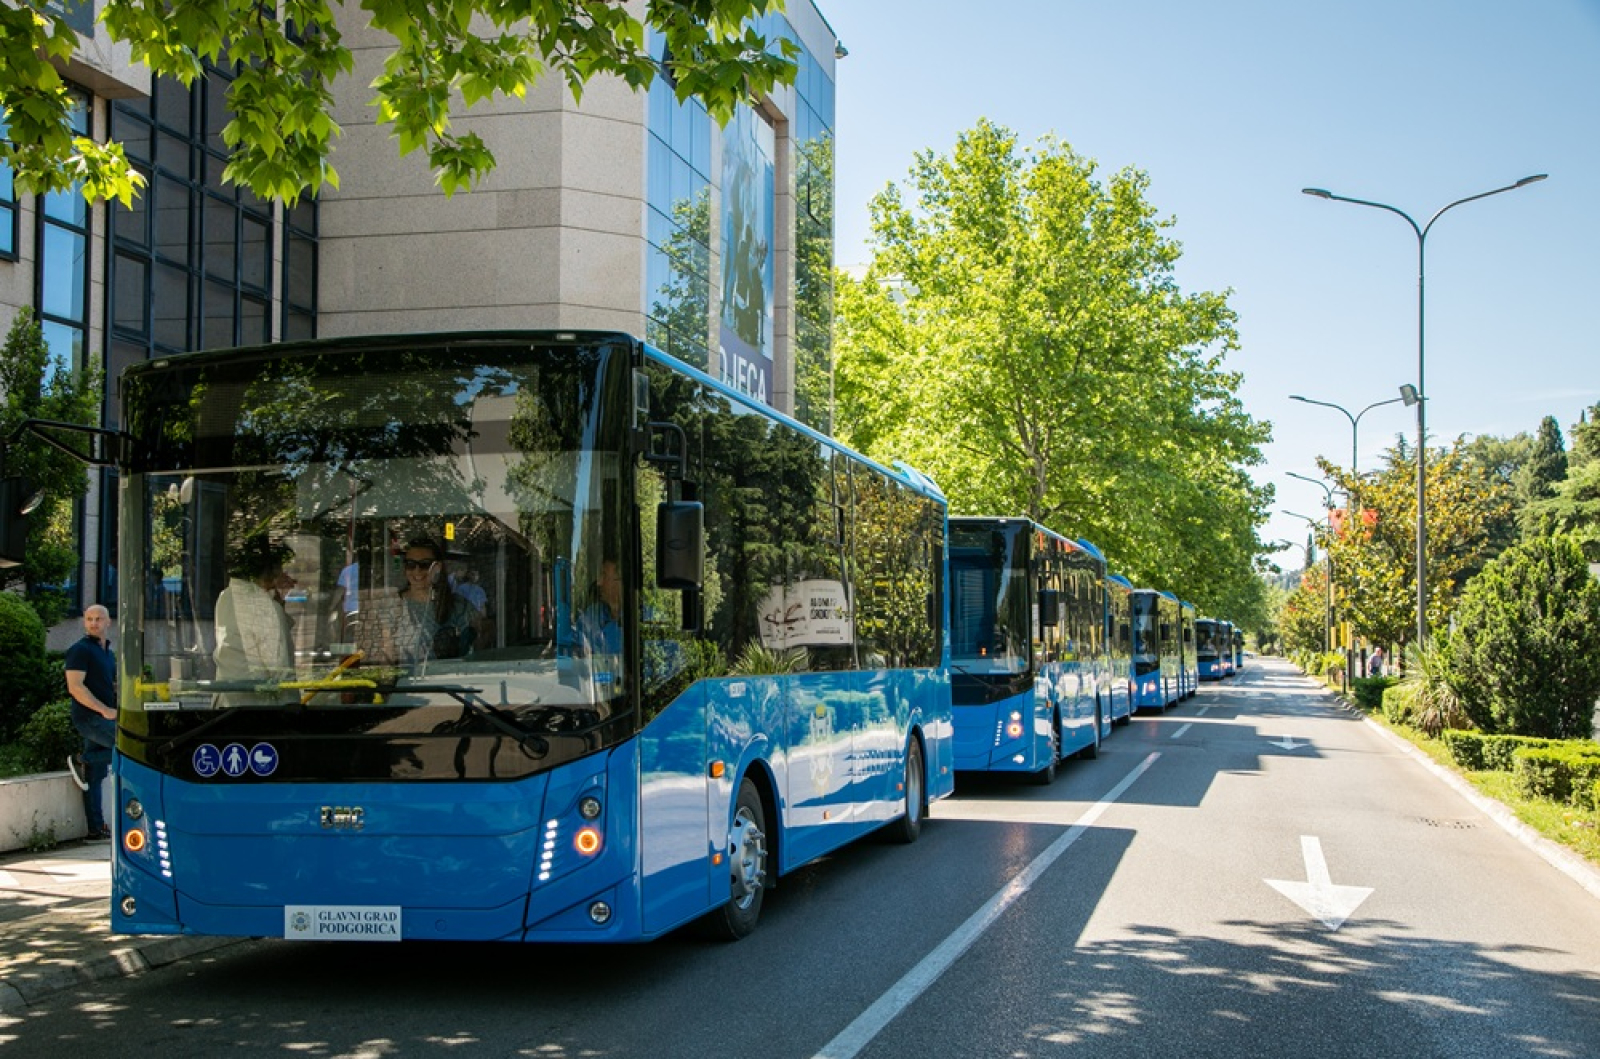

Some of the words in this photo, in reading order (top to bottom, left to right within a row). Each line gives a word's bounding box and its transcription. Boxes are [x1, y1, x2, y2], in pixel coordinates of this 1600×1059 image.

[318, 911, 361, 921] GLAVNI
[363, 911, 398, 922] GRAD
[319, 922, 397, 934] PODGORICA
